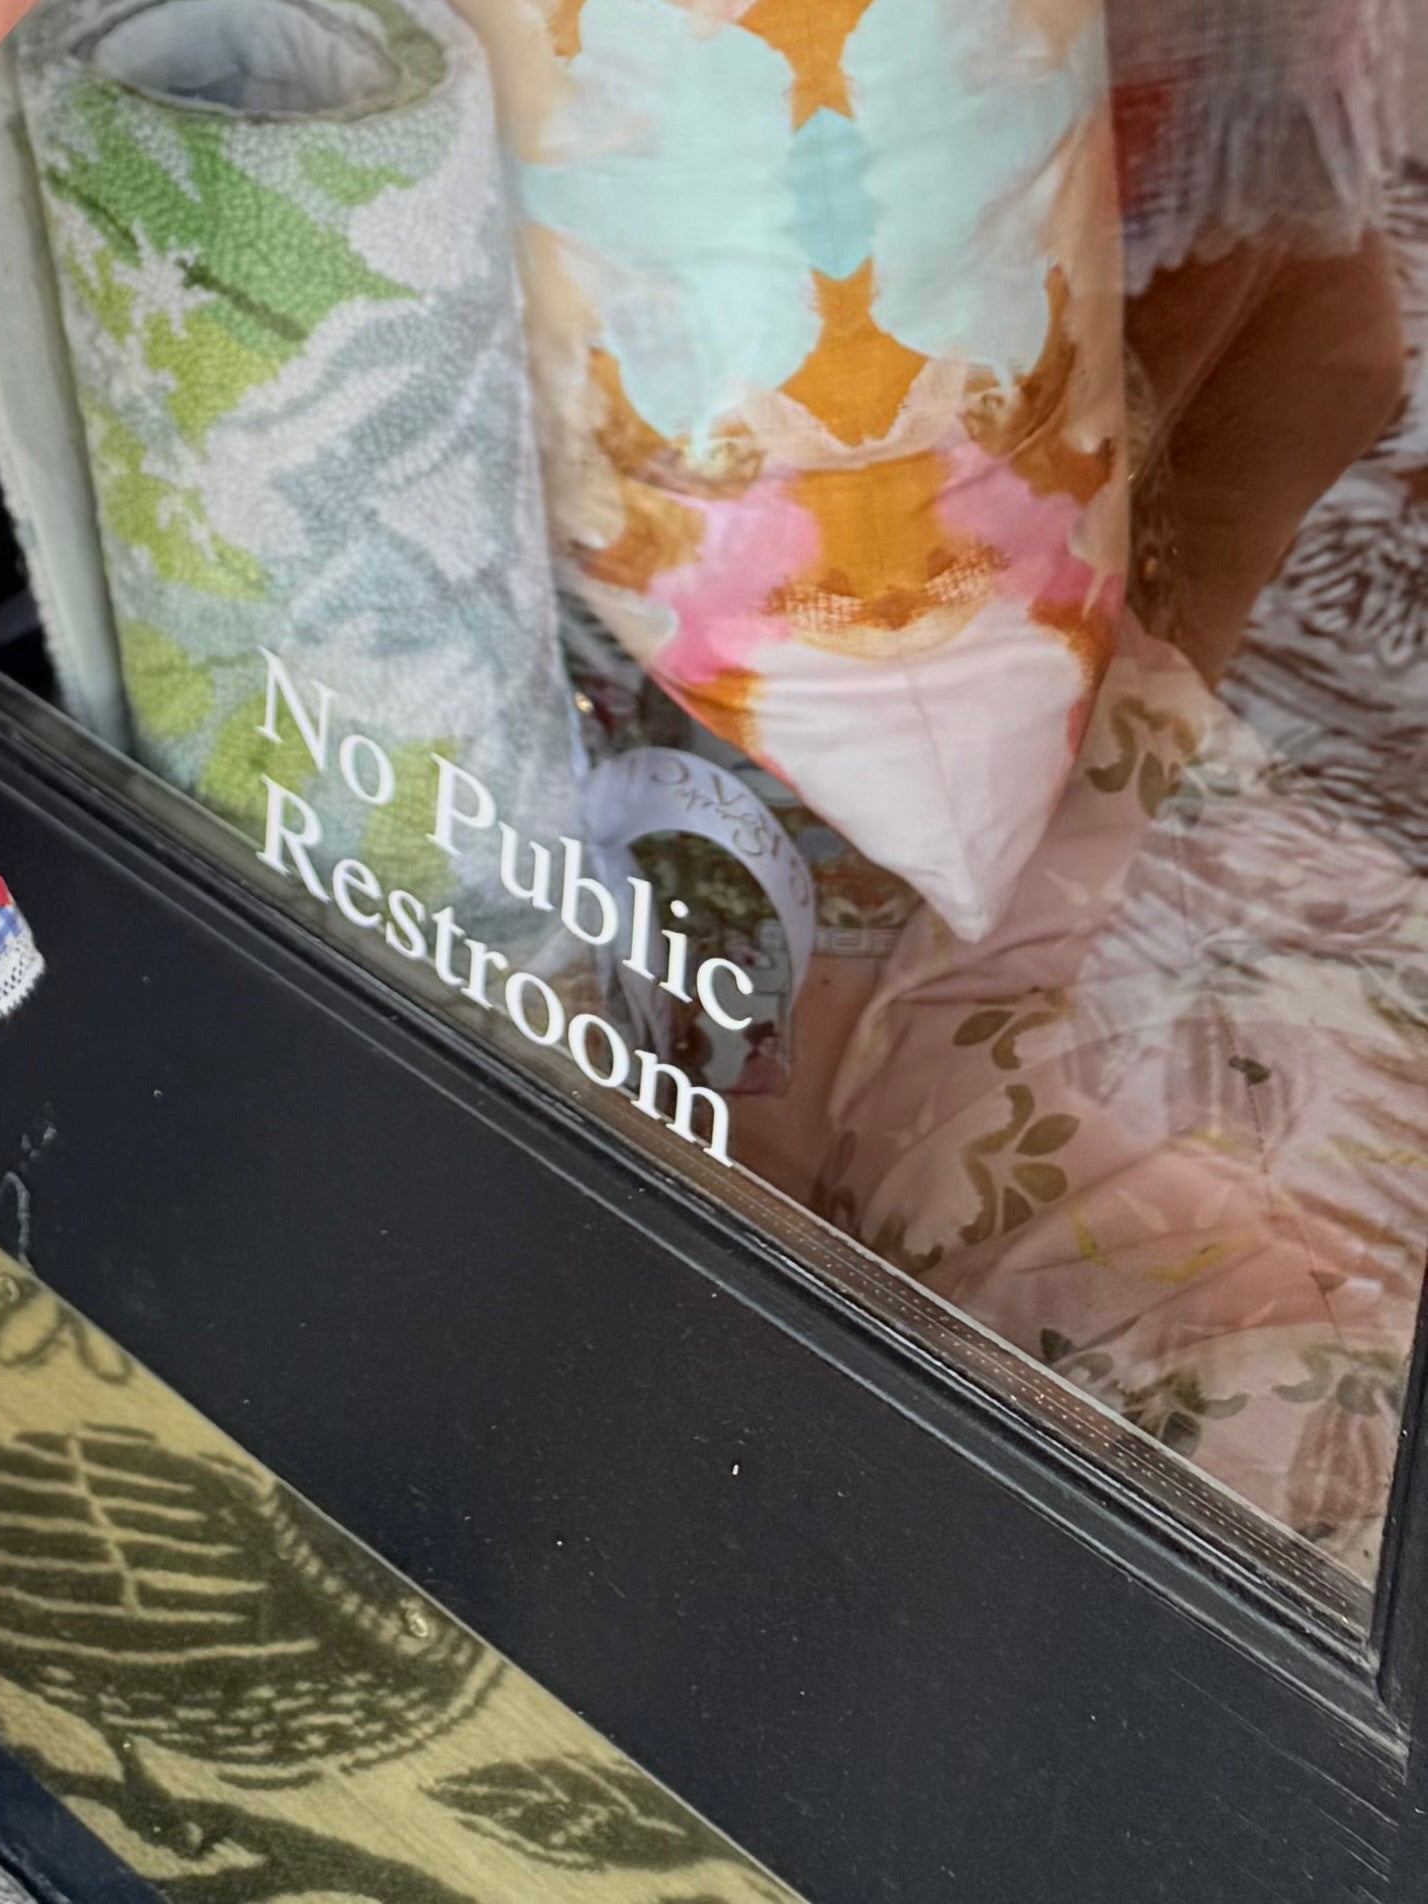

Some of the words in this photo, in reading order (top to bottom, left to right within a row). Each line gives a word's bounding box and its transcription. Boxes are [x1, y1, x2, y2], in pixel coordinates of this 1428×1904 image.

[256, 646, 395, 806] No
[425, 752, 754, 1031] Public
[256, 773, 733, 1168] Restroom
